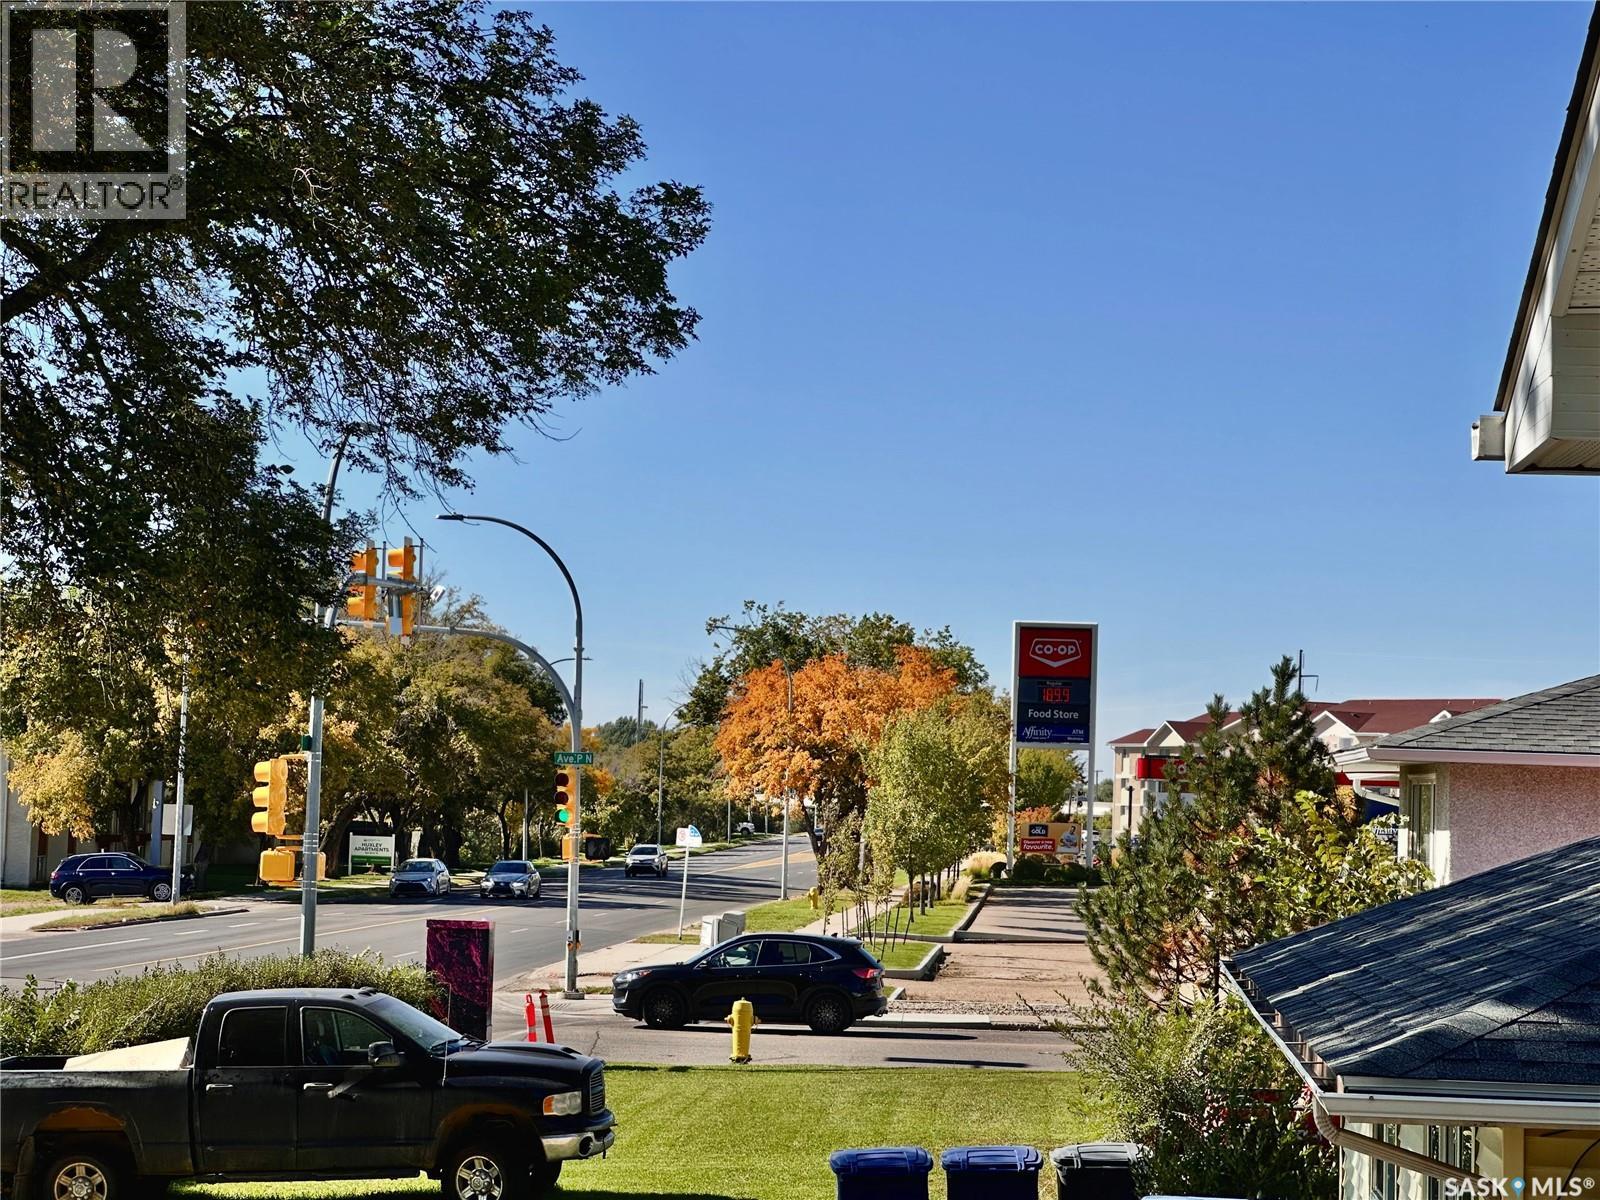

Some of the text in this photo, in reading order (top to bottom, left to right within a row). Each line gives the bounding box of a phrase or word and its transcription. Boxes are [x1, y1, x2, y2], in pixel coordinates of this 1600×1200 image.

[1028, 708, 1079, 719] Food Store
[1022, 726, 1052, 739] Affinity
[577, 754, 583, 763] P
[586, 754, 592, 763] N
